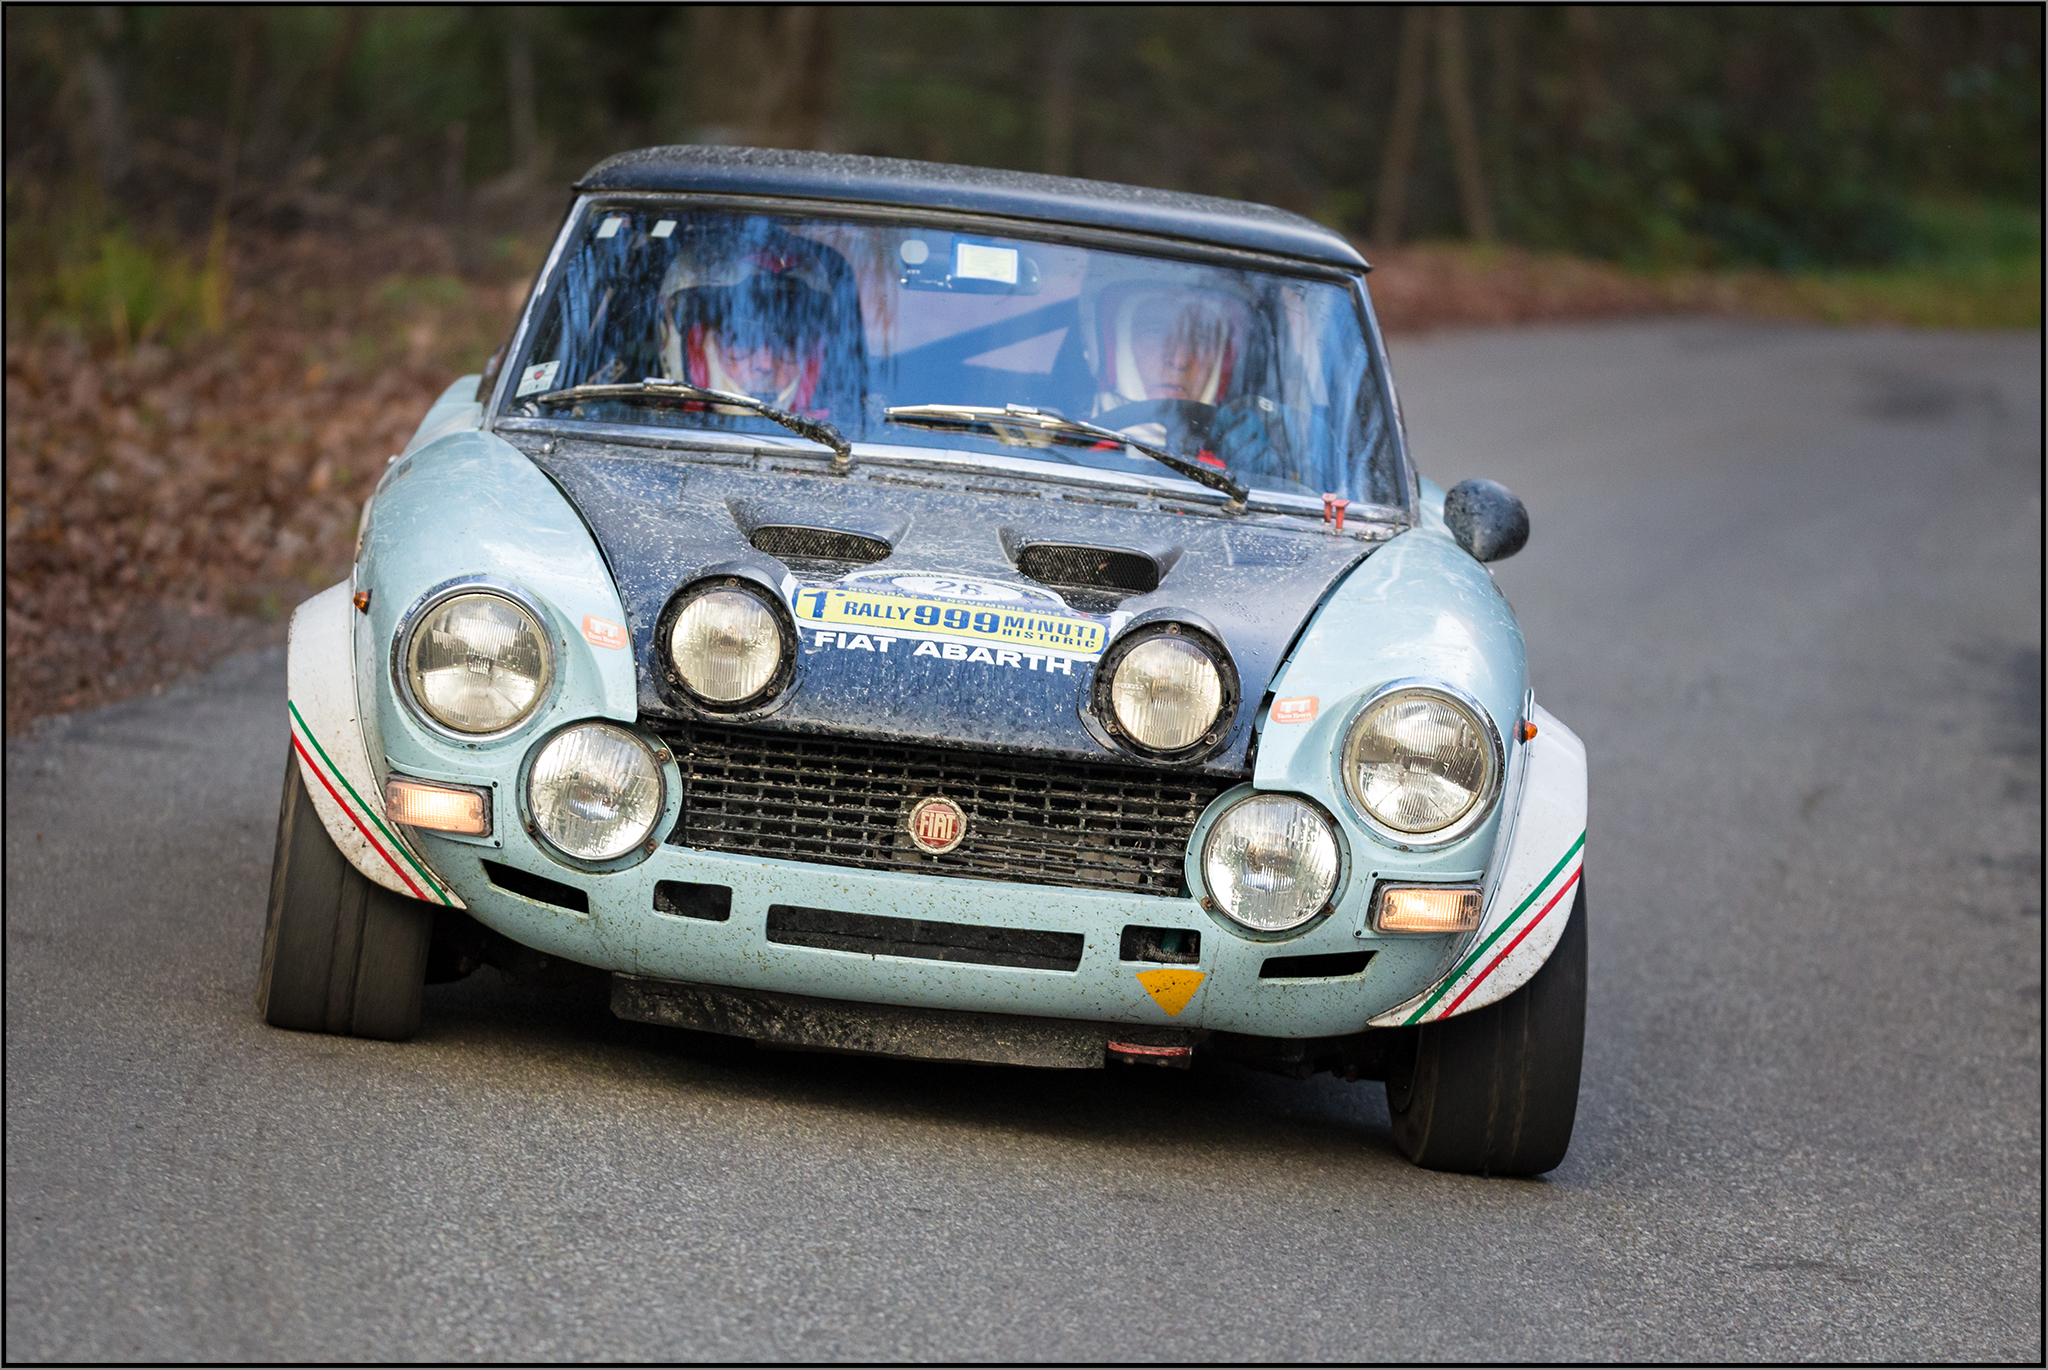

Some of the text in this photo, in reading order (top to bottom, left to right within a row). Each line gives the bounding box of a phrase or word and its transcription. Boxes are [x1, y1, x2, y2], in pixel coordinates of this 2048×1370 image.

[848, 586, 905, 598] NOVARA
[947, 598, 1024, 611] NOVEMBRE
[933, 580, 982, 596] 28
[843, 600, 911, 620] RALLY
[914, 605, 1000, 634] 999
[1004, 615, 1097, 640] MINUTI
[1002, 629, 1095, 648] HISTORIC
[814, 631, 1072, 676] FIAT ABARTH
[920, 811, 956, 839] FIAT
